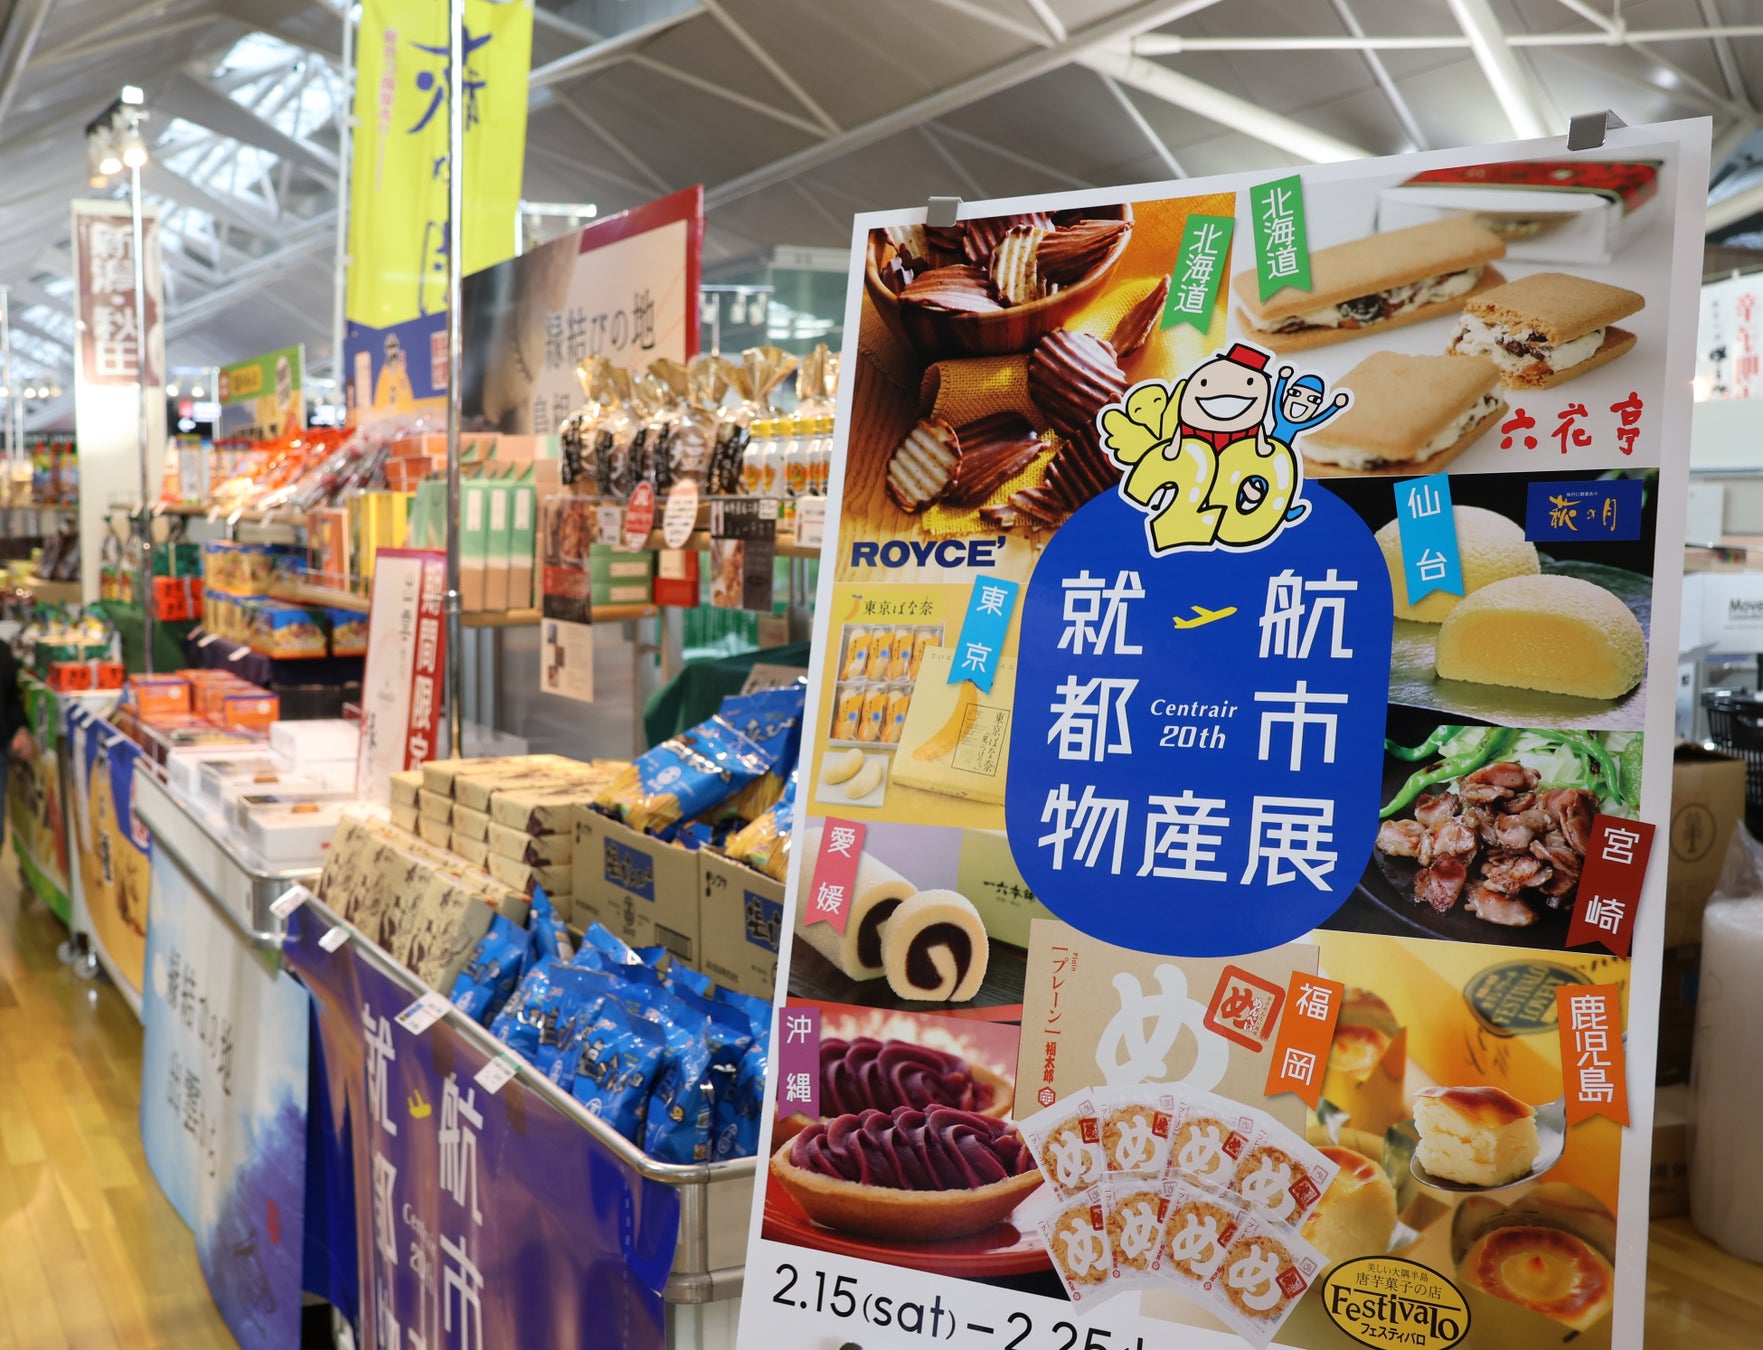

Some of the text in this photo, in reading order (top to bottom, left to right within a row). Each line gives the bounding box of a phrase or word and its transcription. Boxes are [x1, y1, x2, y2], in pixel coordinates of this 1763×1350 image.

[1261, 187, 1300, 280] 北海道
[1173, 224, 1223, 314] 北海道
[1501, 391, 1644, 455] 六花亭
[1124, 436, 1298, 552] 20
[1548, 495, 1618, 532] 萩の月
[851, 536, 1006, 568] ROYCE'
[1407, 485, 1448, 582] 仙台
[863, 599, 934, 616] 東京ばな奈
[960, 585, 1008, 674] 東京
[1150, 699, 1238, 719] Centrair
[1159, 725, 1227, 749] 20th
[816, 826, 856, 915] 愛媛
[1038, 784, 1338, 892] 物産展
[1585, 827, 1640, 935] 宮崎
[1071, 951, 1079, 973] Plain
[1095, 963, 1230, 1095] め
[1243, 997, 1264, 1033] めんべい
[1280, 983, 1333, 1086] 福岡
[1570, 995, 1615, 1103] 鹿児島
[786, 1015, 812, 1103] 沖縄
[1043, 1041, 1057, 1084] 福太郎
[773, 1263, 956, 1340] 2.15(sat)
[1355, 1272, 1443, 1300] 唐芋菓子の店
[1367, 1262, 1429, 1282] 美しい大隅半島
[1331, 1284, 1460, 1341] Festivalo
[1361, 1322, 1426, 1346] フェスティバロ
